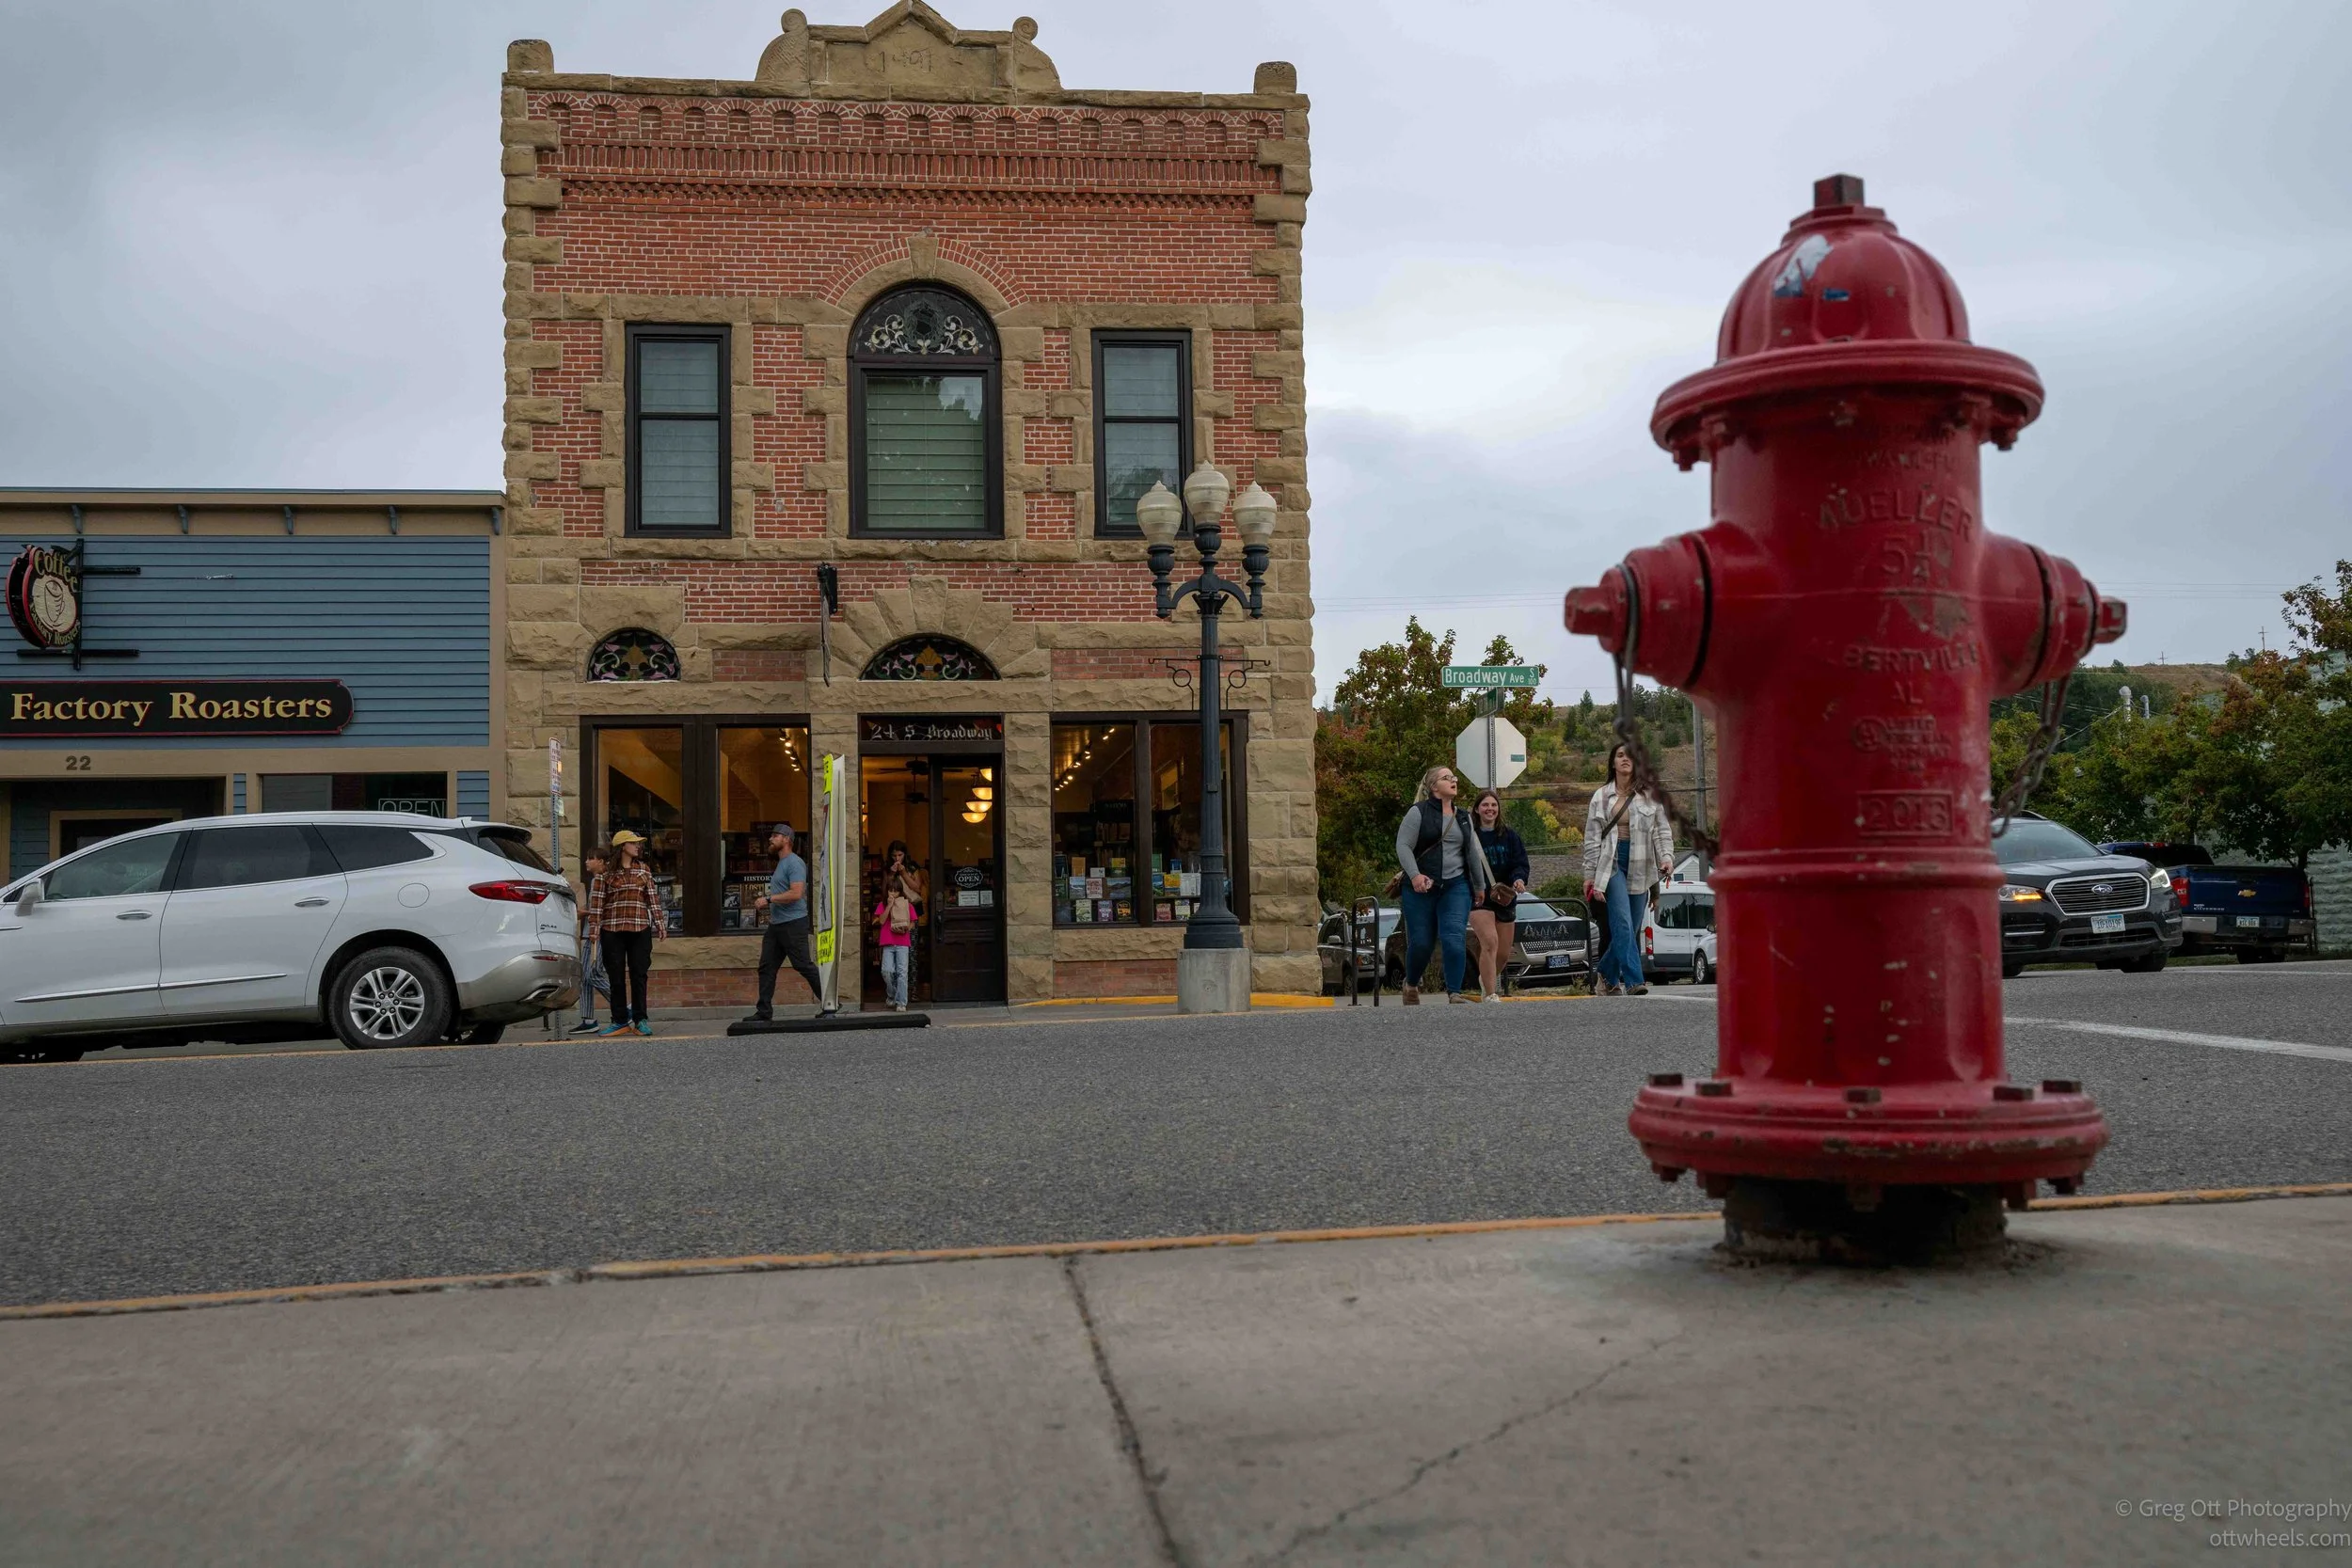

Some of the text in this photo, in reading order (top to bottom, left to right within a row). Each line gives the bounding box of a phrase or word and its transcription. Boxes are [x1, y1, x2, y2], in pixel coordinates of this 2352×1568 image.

[34, 550, 78, 594] Coffee
[1444, 668, 1535, 686] Broadway Ave S
[10, 691, 333, 727] Factory Roasters
[871, 723, 895, 739] 24
[927, 723, 993, 740] Broadway
[65, 755, 91, 770] 22
